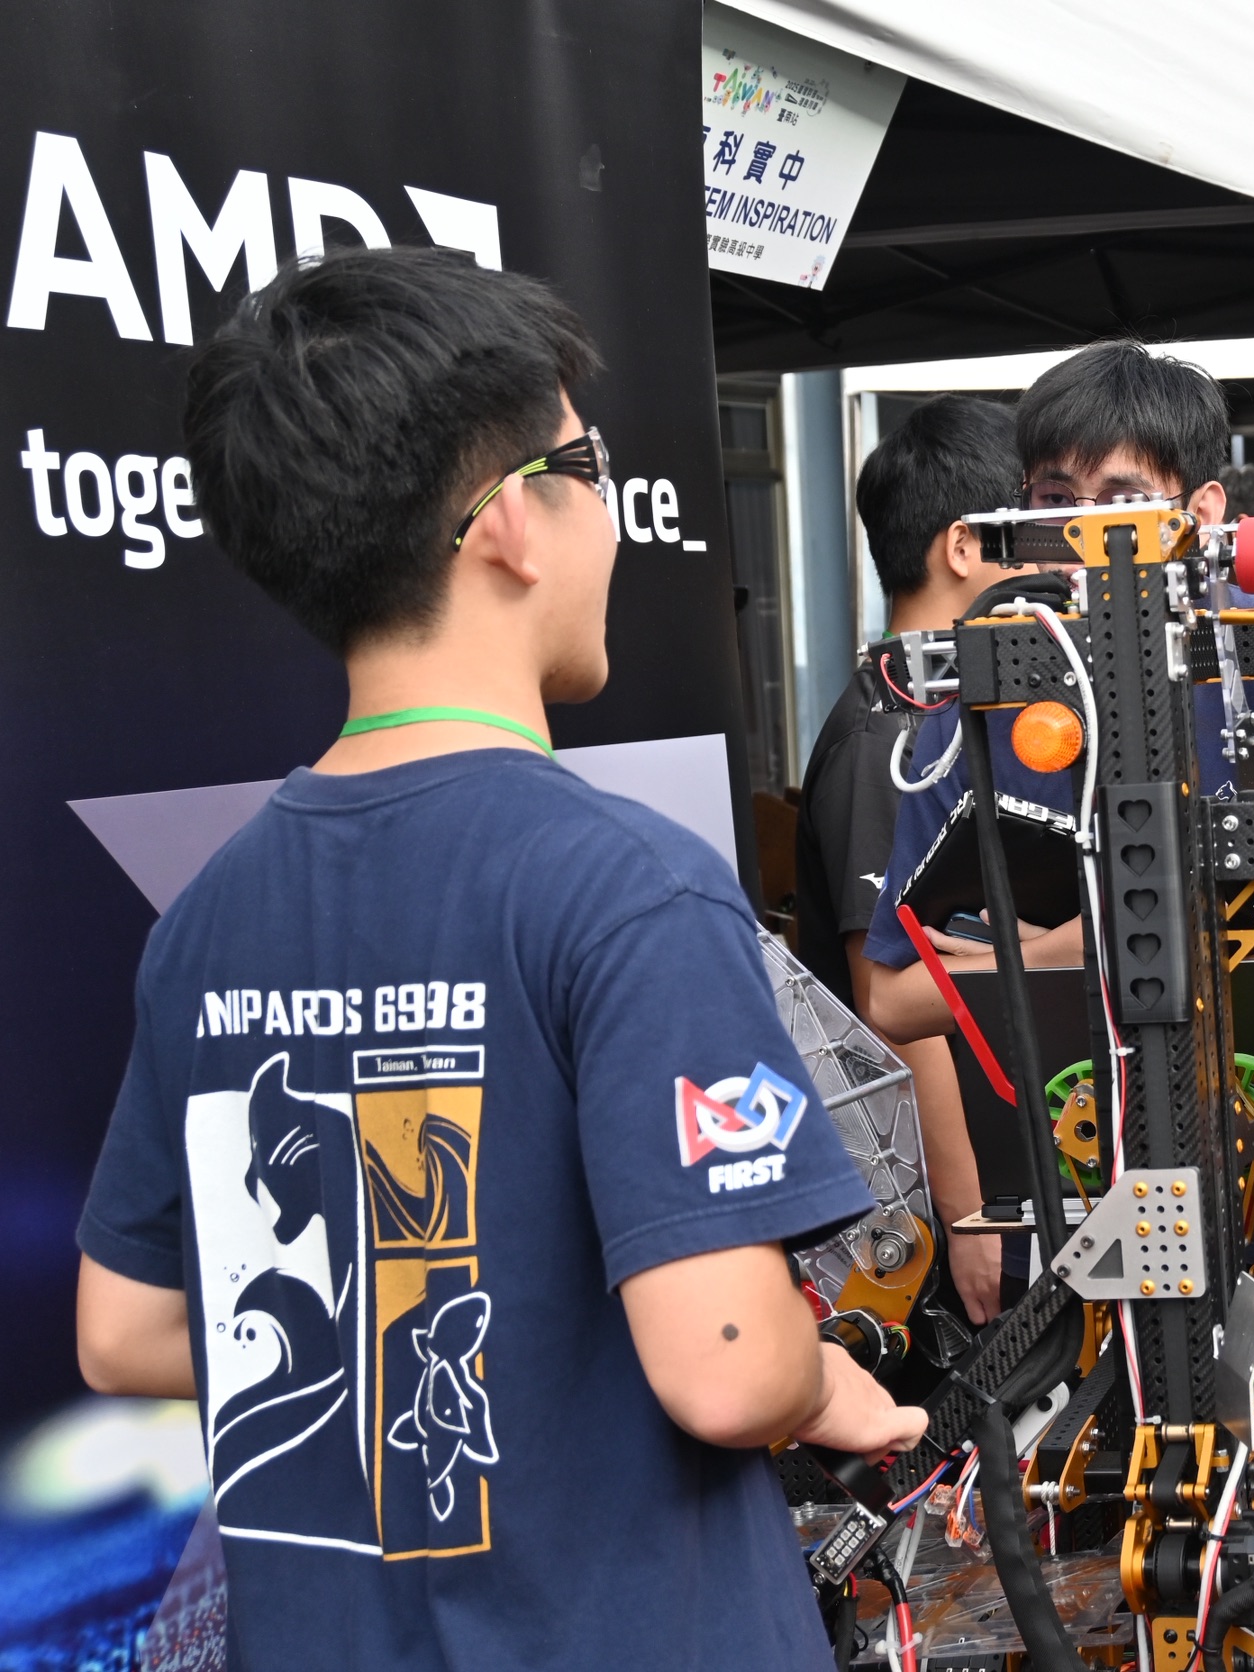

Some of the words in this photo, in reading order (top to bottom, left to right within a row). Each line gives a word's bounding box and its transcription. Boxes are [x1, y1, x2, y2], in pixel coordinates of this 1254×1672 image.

[731, 194, 838, 245] INSPIRATION
[20, 428, 204, 569] toge
[196, 989, 363, 1038] NIPARDS
[708, 1154, 787, 1194] FIRST
